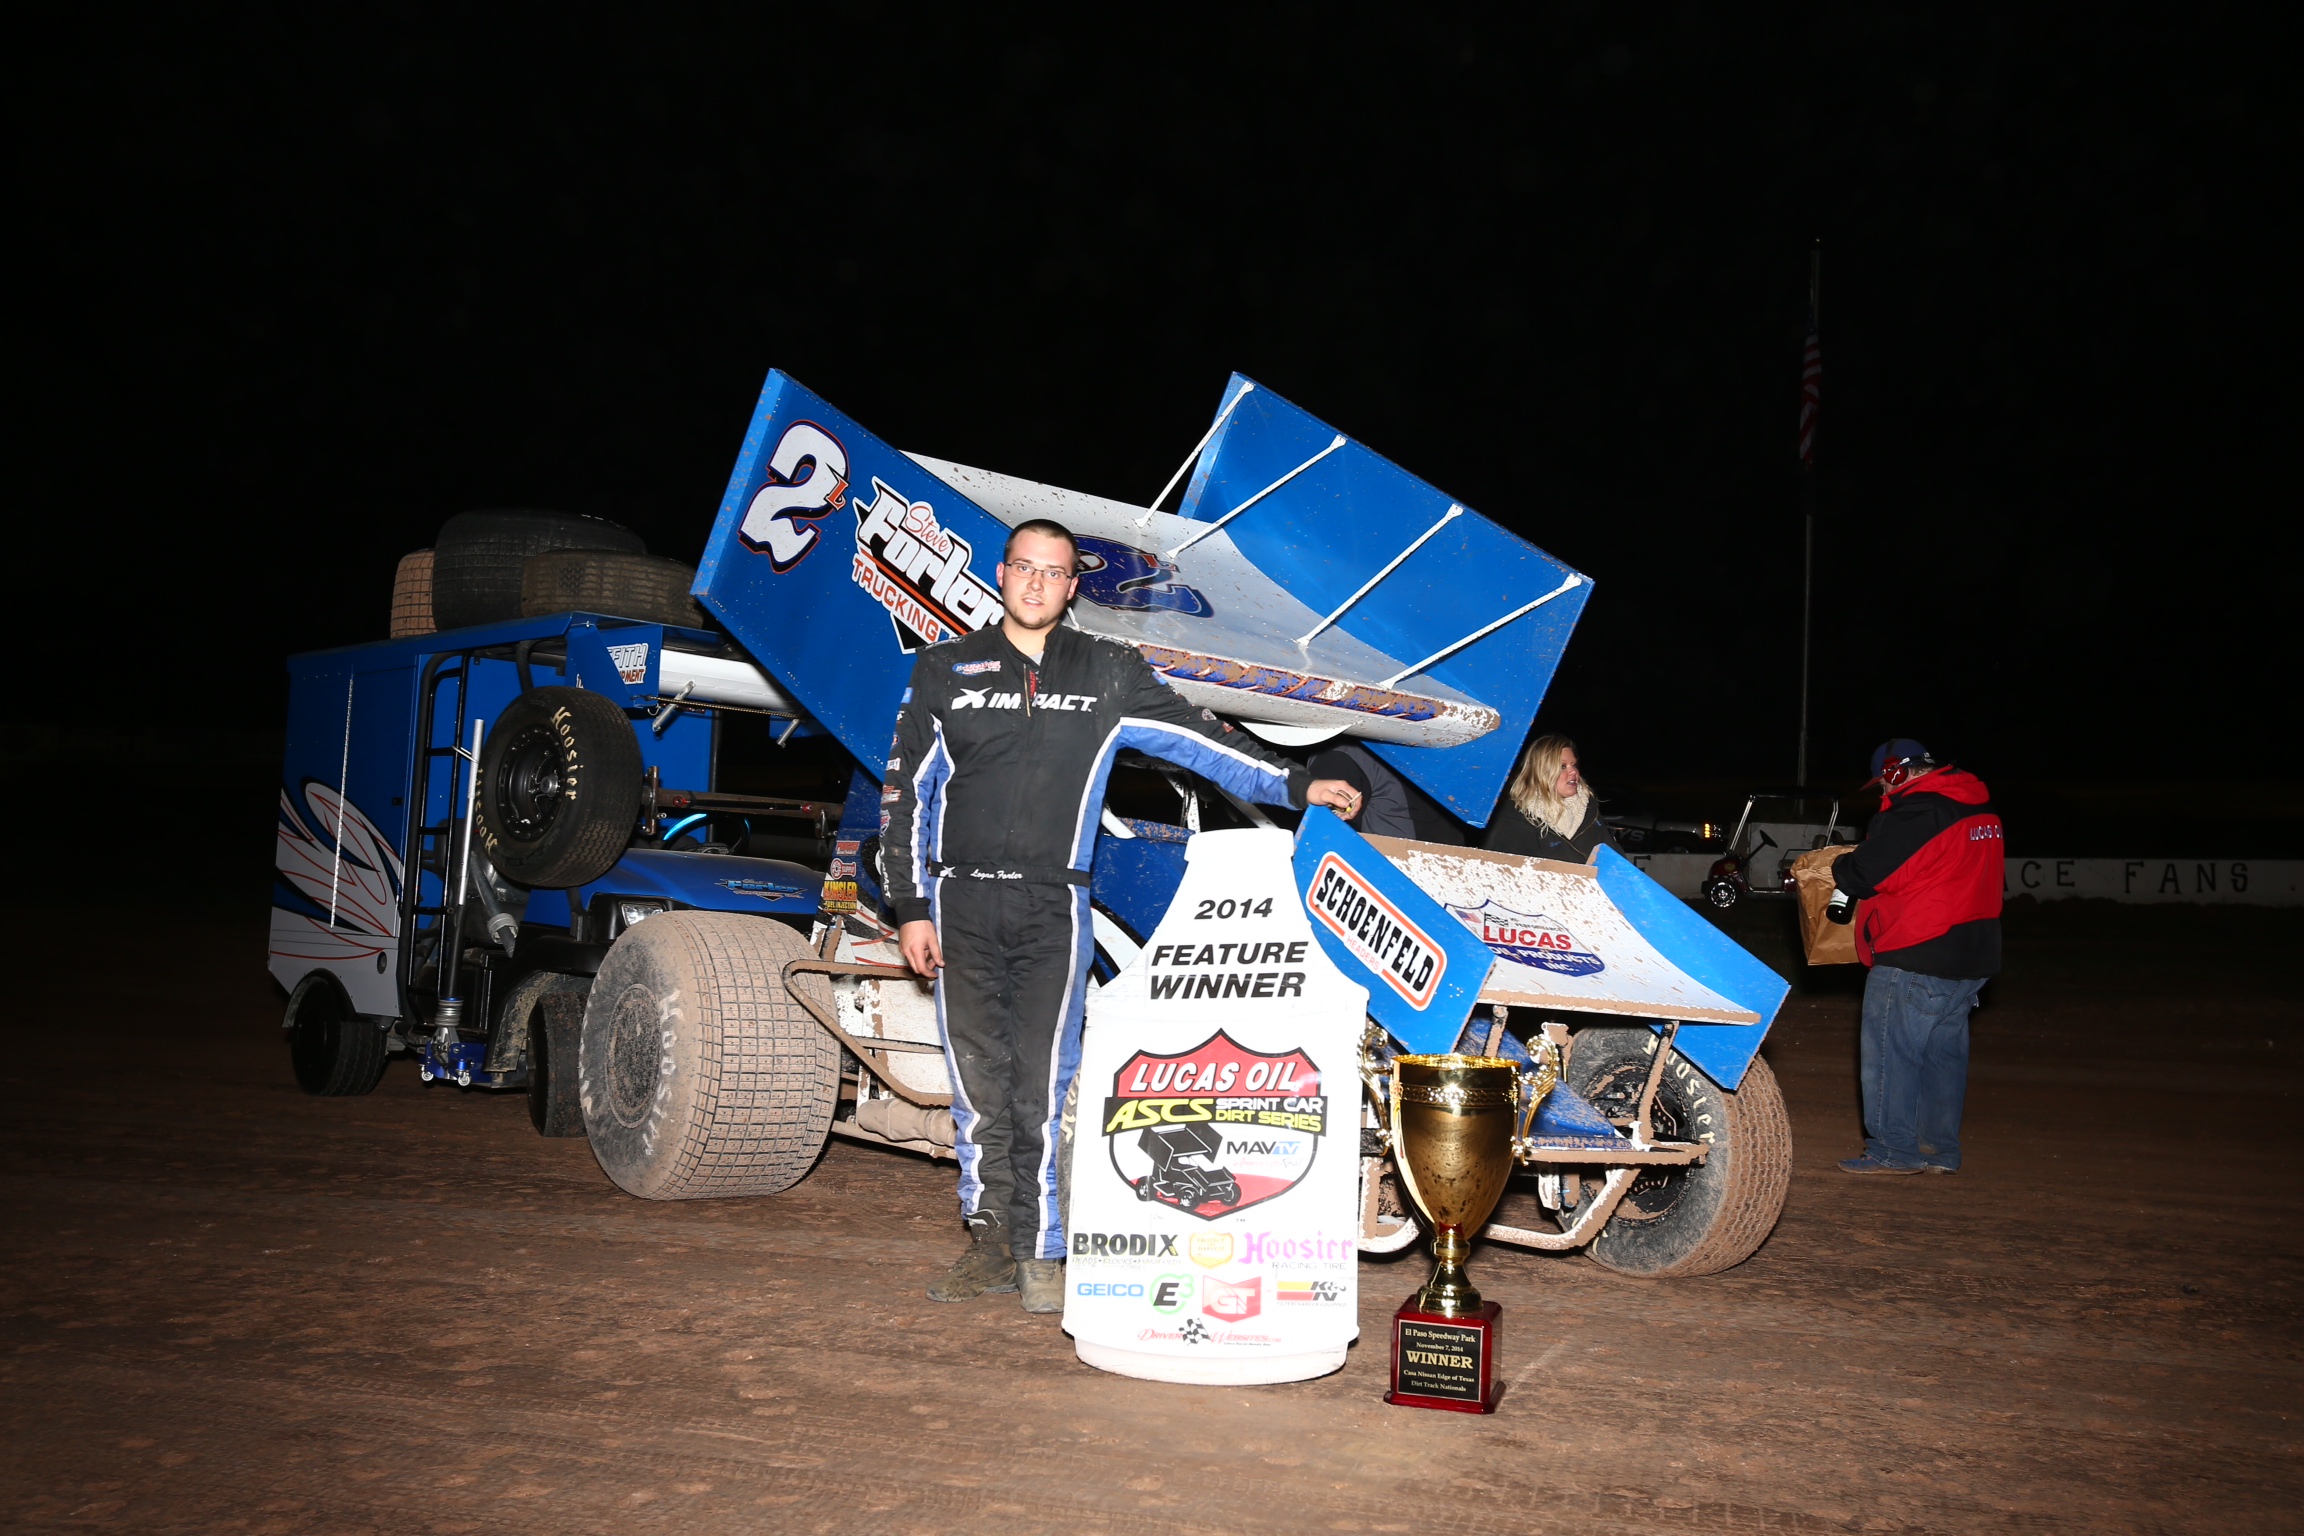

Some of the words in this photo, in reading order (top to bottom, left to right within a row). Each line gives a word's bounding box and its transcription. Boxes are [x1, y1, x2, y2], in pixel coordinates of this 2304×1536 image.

[738, 419, 848, 574] 2
[904, 504, 950, 553] Steve
[857, 487, 1004, 630] Forler
[853, 557, 940, 642] TRUCKING
[607, 645, 647, 668] FITH
[551, 706, 583, 800] Hoosier
[1970, 825, 1993, 840] LUCAS
[970, 868, 995, 880] Logan
[2125, 861, 2249, 894] FANS
[824, 881, 857, 900] KINSLER
[1194, 898, 1273, 920] 2014
[1316, 867, 1435, 992] SCHOENFELD
[1483, 925, 1572, 951] LUCAS
[1151, 941, 1309, 966] FEATURE
[1346, 937, 1380, 971] HEADERS
[1518, 949, 1601, 966] PRODUCTS
[1150, 972, 1306, 1000] WINNER
[1129, 1061, 1241, 1093] LUCAS
[1244, 1061, 1298, 1093] OIL
[1106, 1098, 1215, 1133] ASCS
[1215, 1098, 1281, 1112] SPRINT
[1283, 1098, 1324, 1114] CAR
[1215, 1110, 1256, 1122] DIRT
[1258, 1111, 1322, 1132] SERIES
[1226, 1141, 1302, 1155] MAVTV
[1072, 1233, 1179, 1257] BRODIX
[1237, 1230, 1354, 1264] Hoosier
[1272, 1262, 1318, 1270] RACING
[1077, 1283, 1144, 1297] GEICO
[1405, 1328, 1411, 1336] El
[1413, 1330, 1428, 1338] Paso
[1428, 1331, 1460, 1343] Speedway
[1461, 1334, 1476, 1343] Park
[1416, 1342, 1445, 1351] November
[1405, 1350, 1474, 1370] WINNER
[1417, 1371, 1437, 1379] Nissan
[1437, 1373, 1451, 1381] Edge
[1459, 1375, 1475, 1383] Texas
[1440, 1383, 1467, 1392] Nationals
